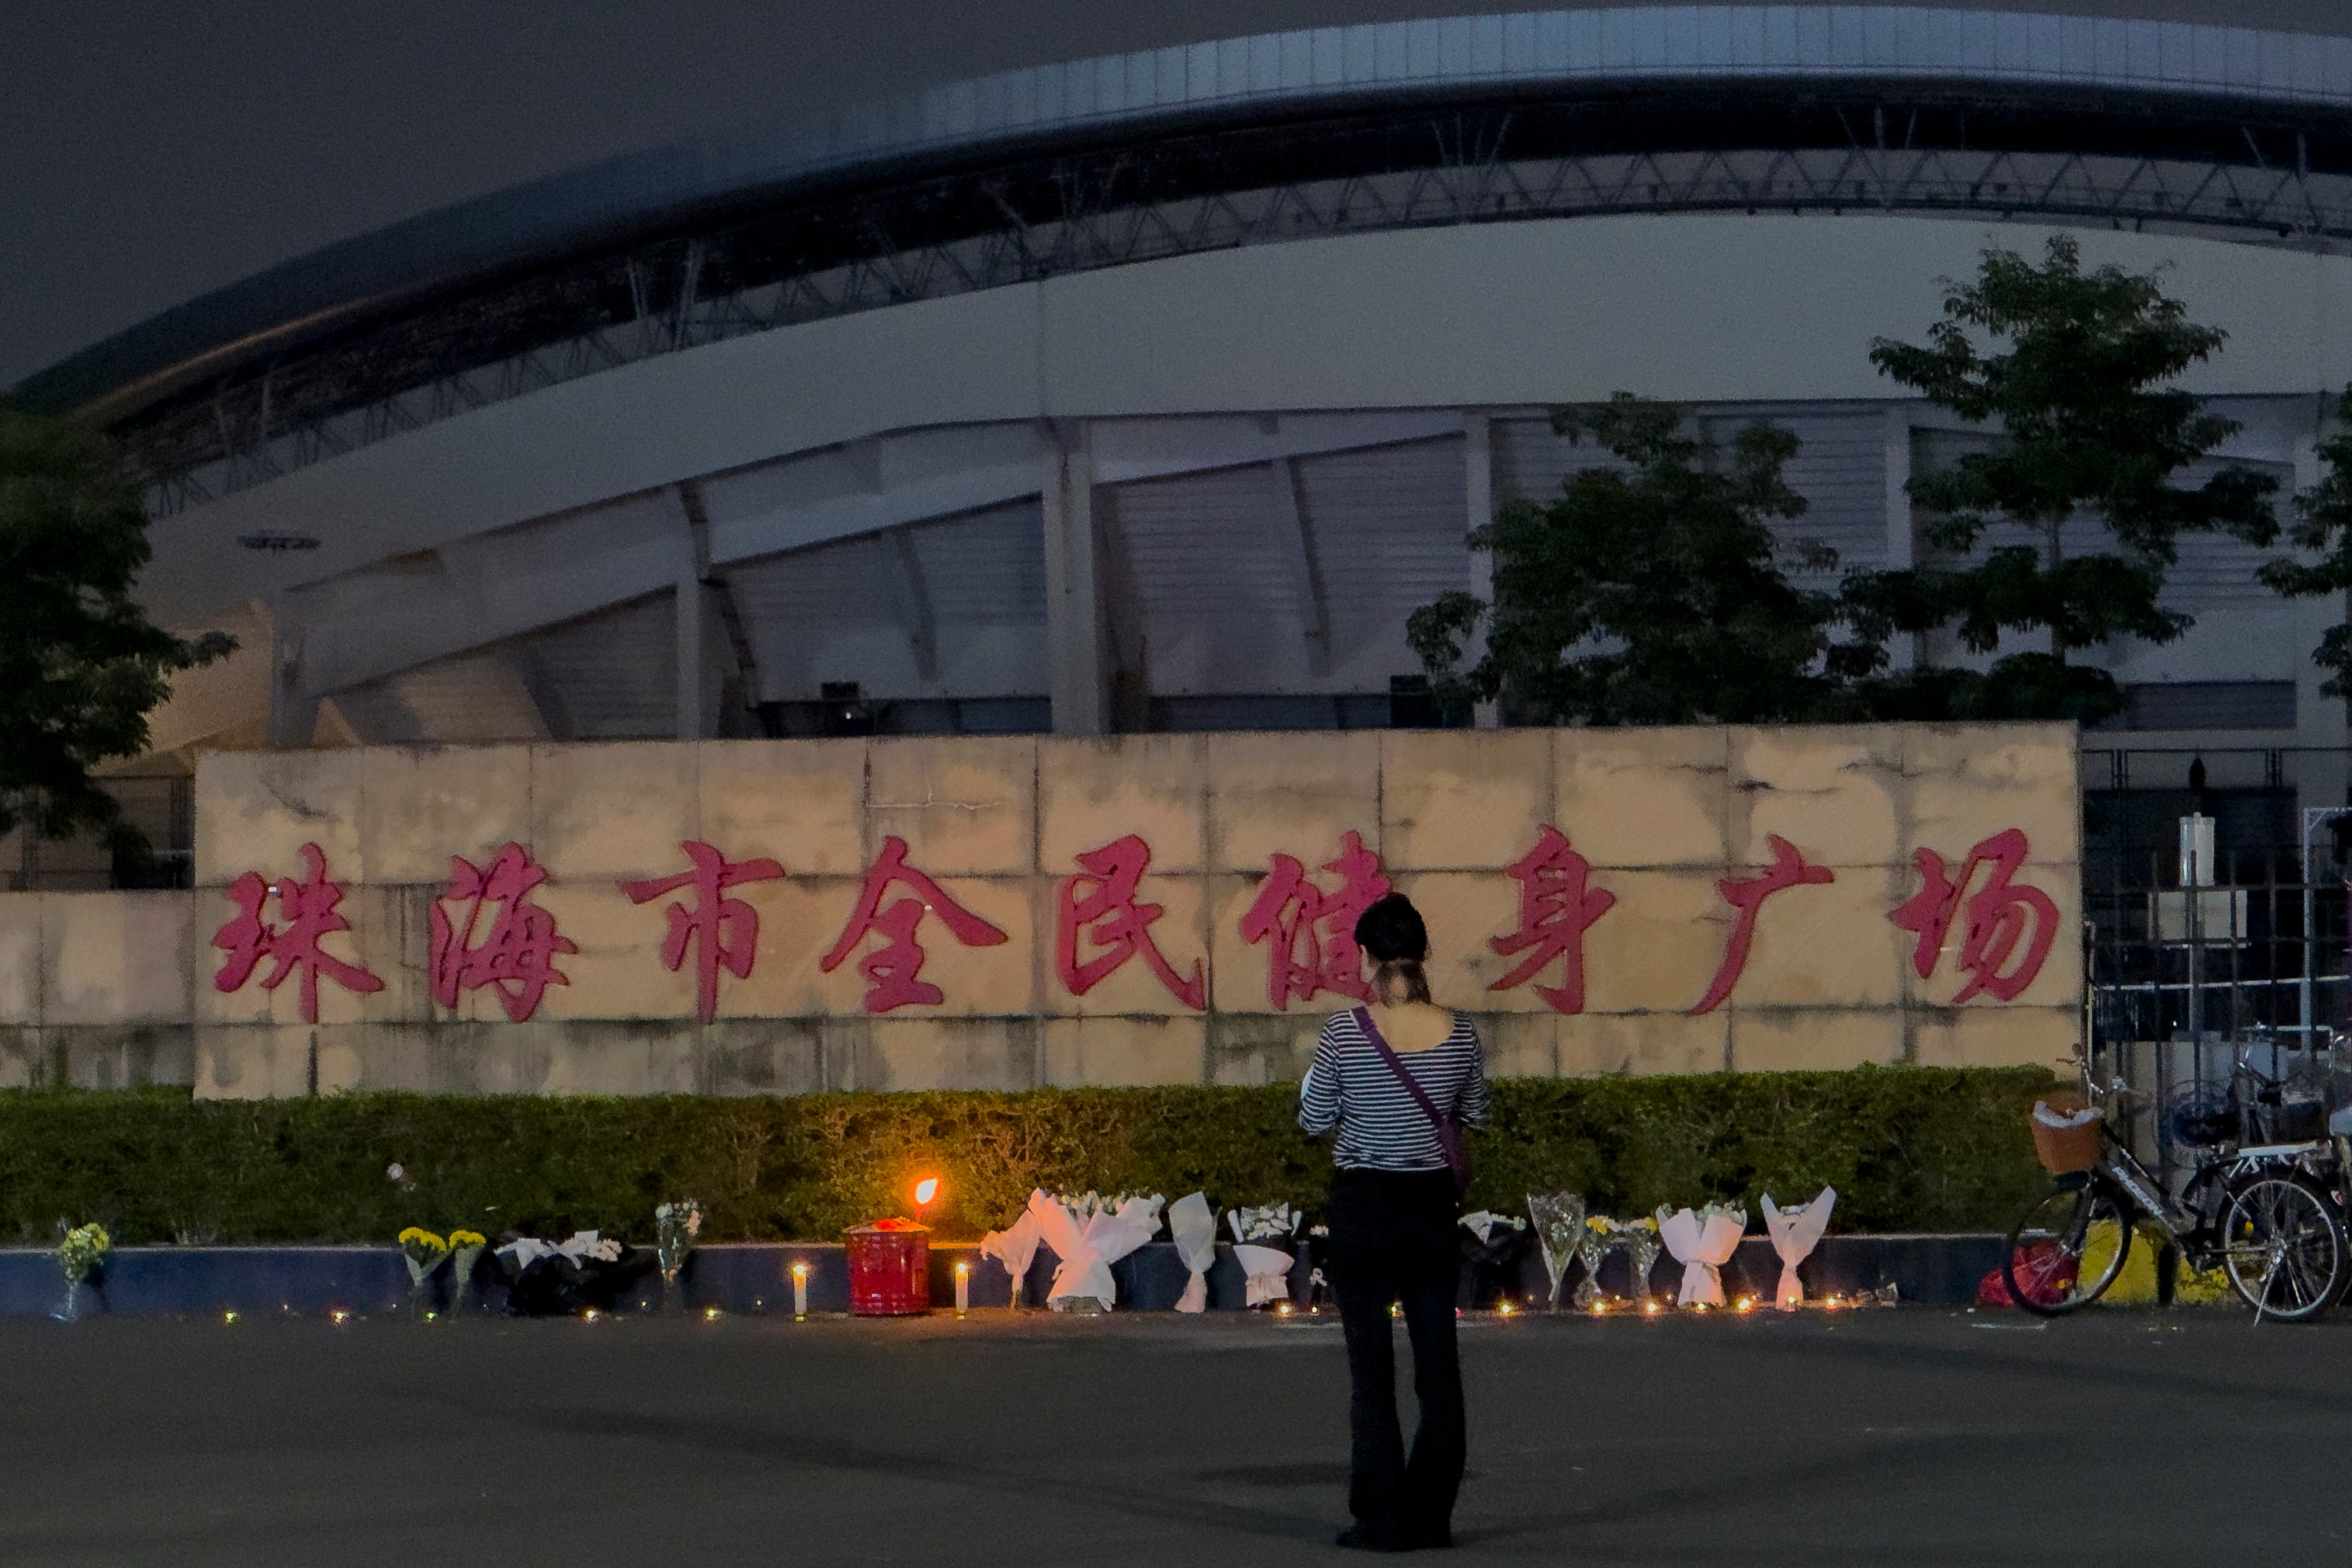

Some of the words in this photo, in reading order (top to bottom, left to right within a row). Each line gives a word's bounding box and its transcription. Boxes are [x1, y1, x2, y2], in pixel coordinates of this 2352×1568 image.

[213, 826, 2059, 1022] 珠海市全民健身广场
